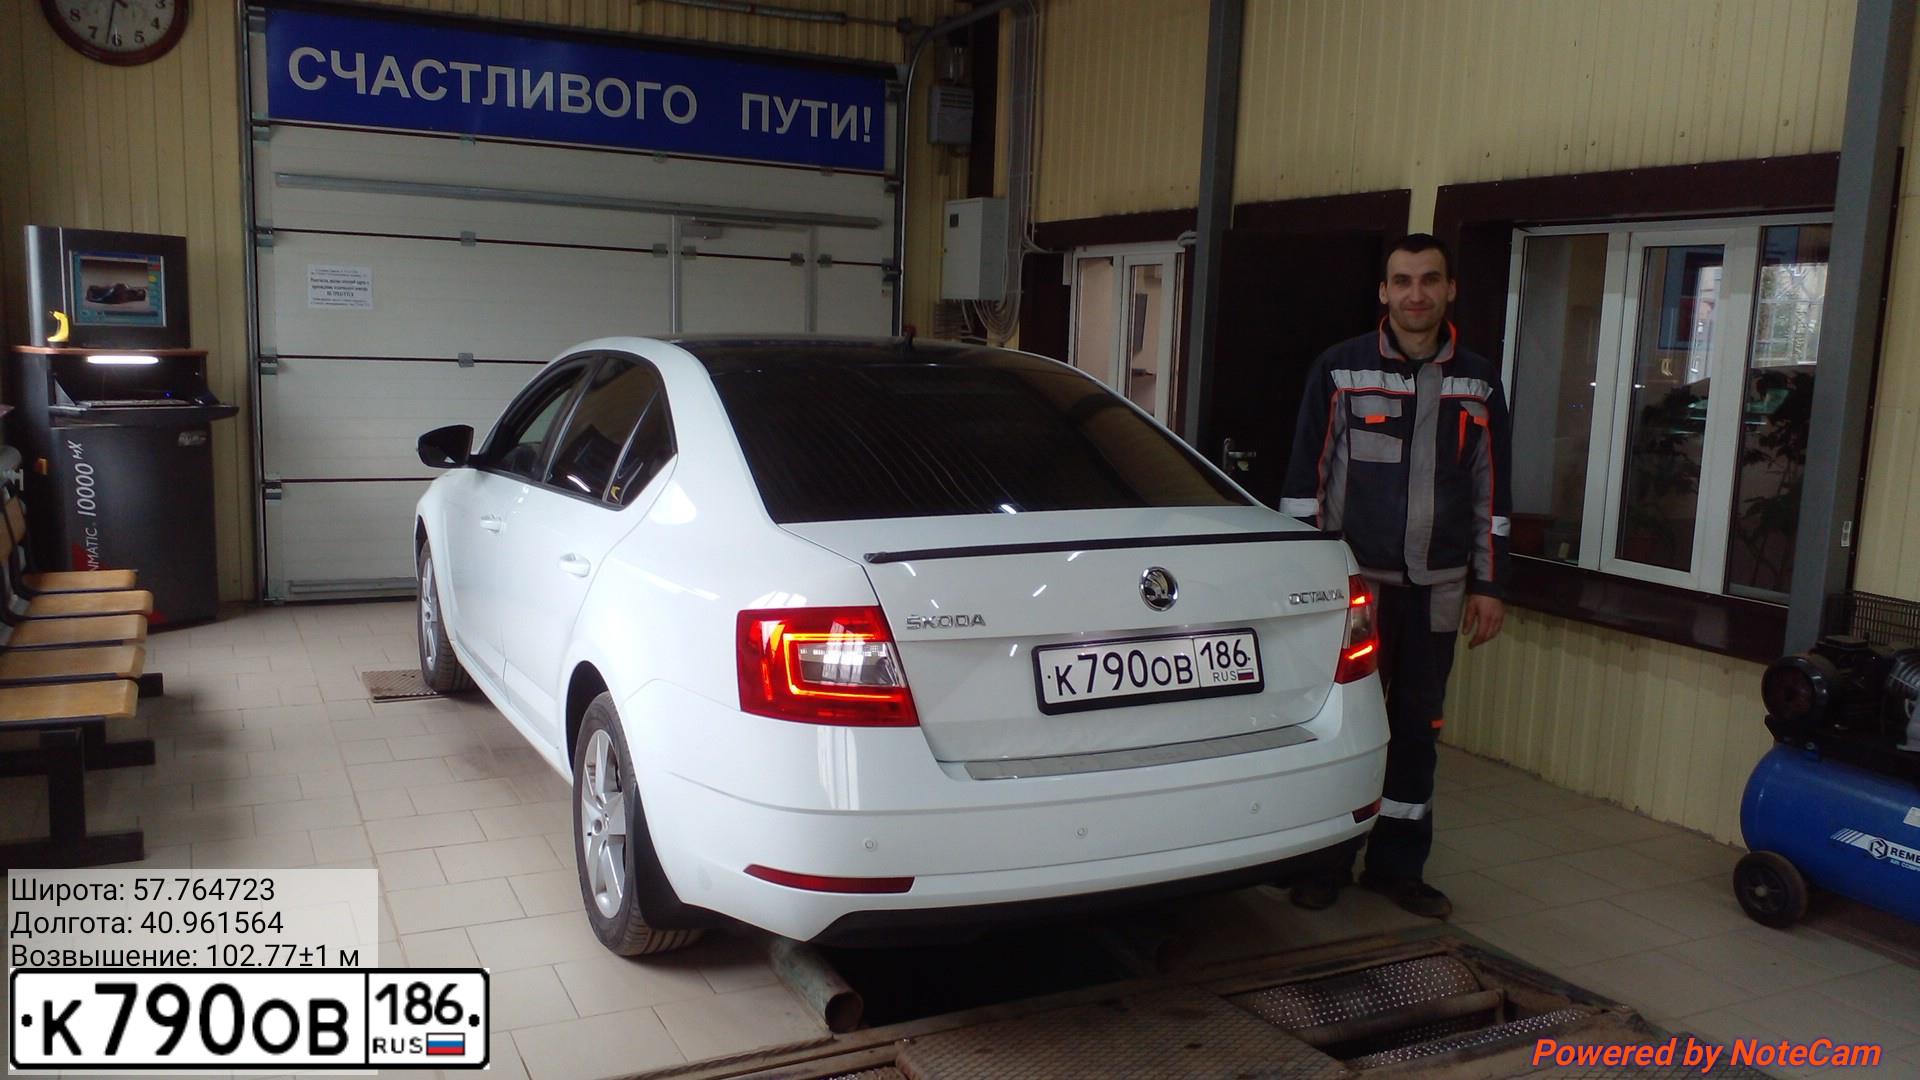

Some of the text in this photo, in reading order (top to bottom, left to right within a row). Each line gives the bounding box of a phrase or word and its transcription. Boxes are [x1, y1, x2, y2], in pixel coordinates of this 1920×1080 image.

[69, 8, 81, 22] 8
[151, 17, 160, 30] 4
[88, 26, 98, 40] 7
[111, 33, 122, 47] 6
[134, 30, 145, 44] 5
[288, 46, 872, 143] СЧАСТЛИВОГО ПУТИ!
[75, 463, 97, 517] 10000
[1200, 639, 1248, 670] 186
[1212, 669, 1237, 683] RUS
